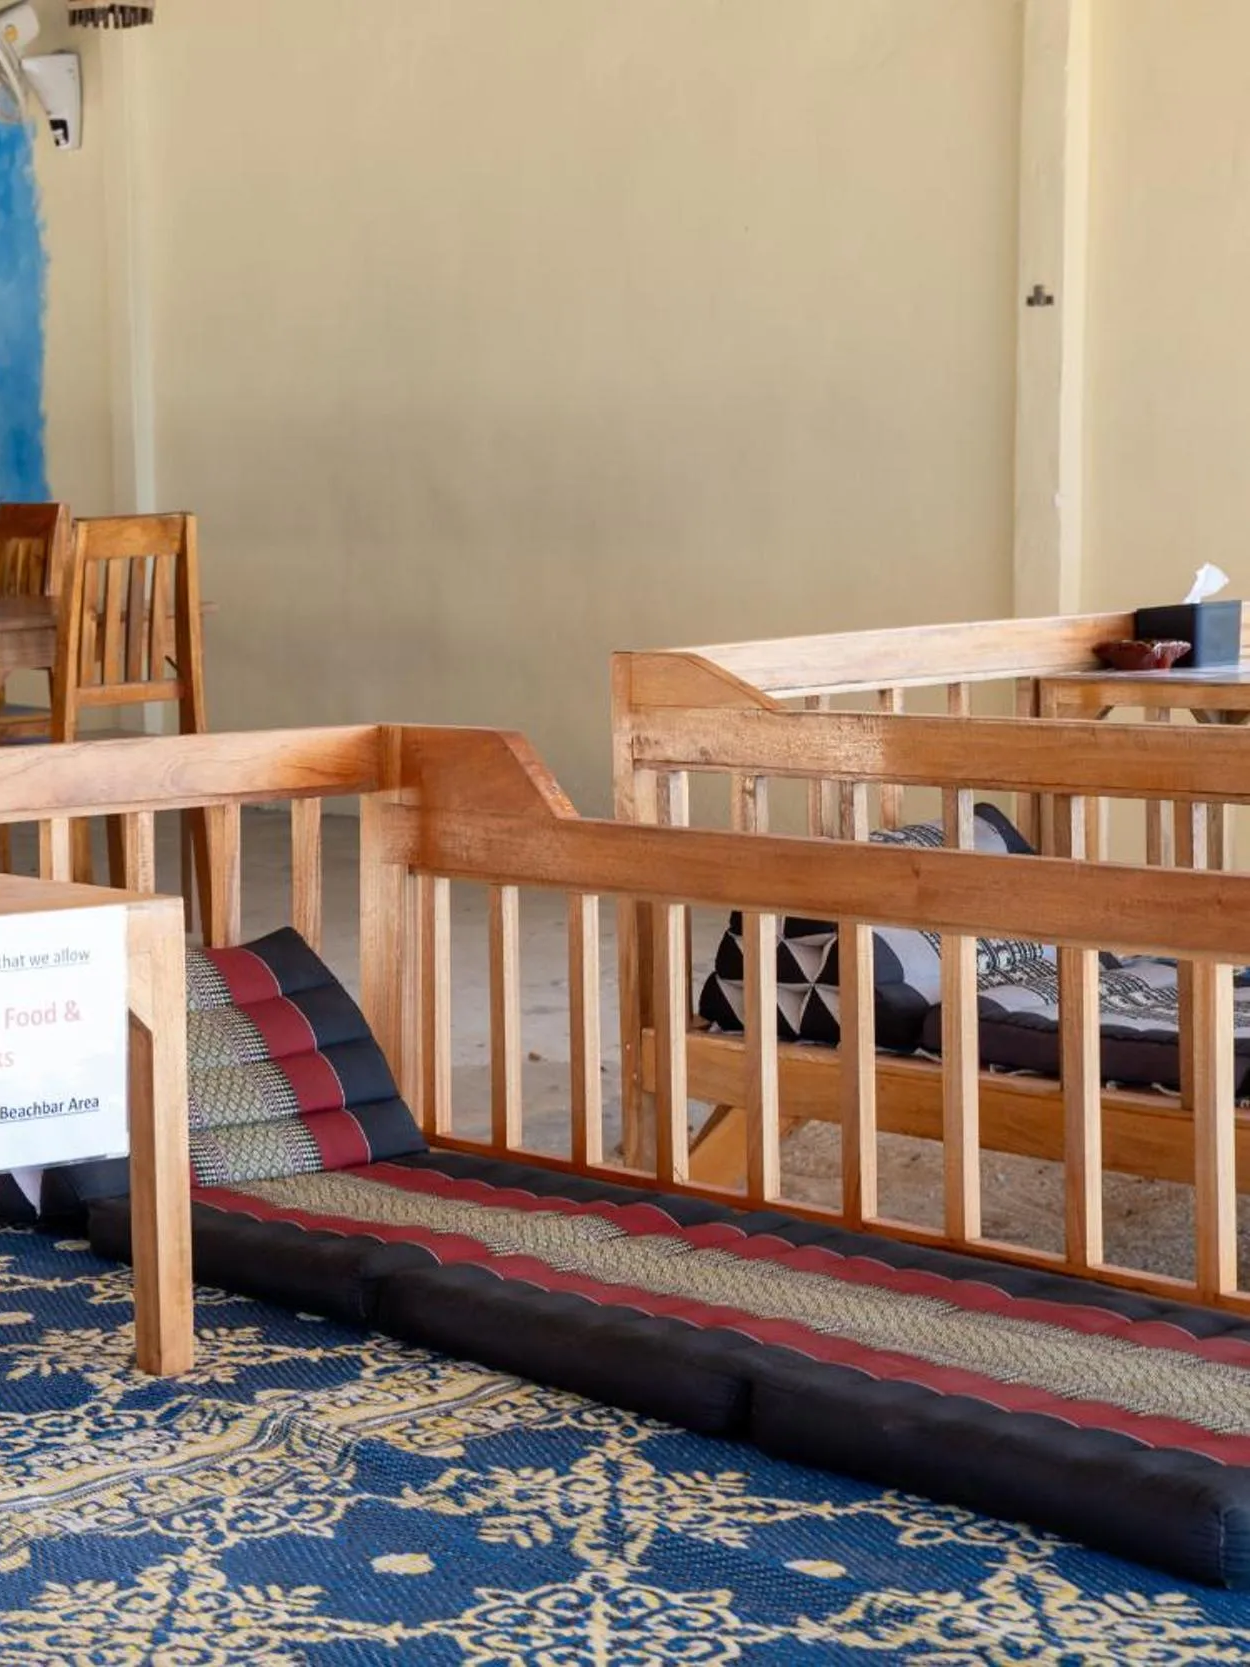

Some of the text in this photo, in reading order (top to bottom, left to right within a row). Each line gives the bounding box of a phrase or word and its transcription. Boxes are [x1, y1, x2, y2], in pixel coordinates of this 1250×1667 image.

[30, 953, 49, 966] we
[54, 946, 90, 962] allow
[5, 1001, 57, 1030] Food
[64, 999, 82, 1022] &
[0, 1101, 64, 1120] Beachbar
[68, 1096, 100, 1111] Area
